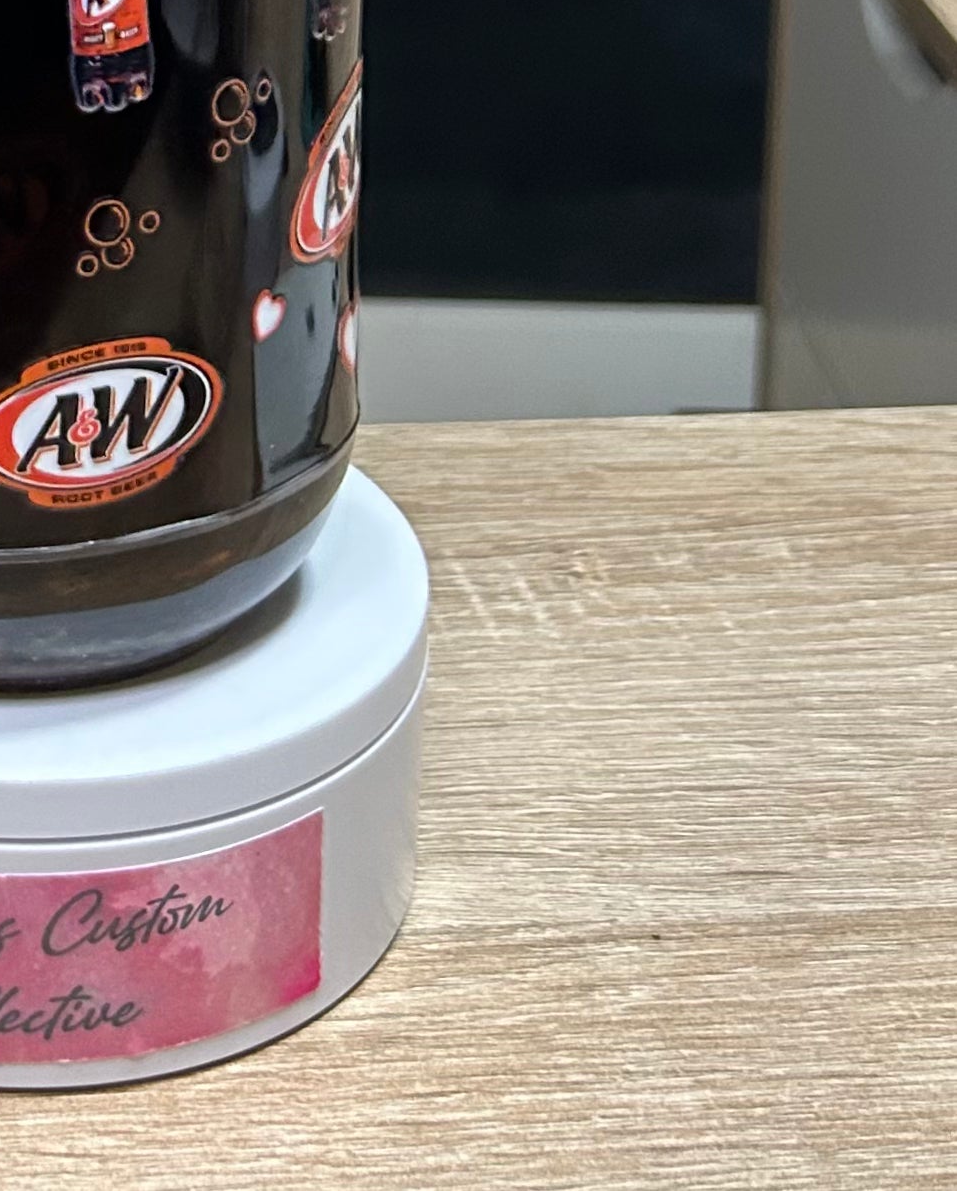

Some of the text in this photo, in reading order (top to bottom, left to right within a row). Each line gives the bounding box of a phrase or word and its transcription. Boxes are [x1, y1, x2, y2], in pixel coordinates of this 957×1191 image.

[47, 347, 105, 371] SINCE
[15, 365, 183, 474] A&W
[51, 471, 158, 505] ROOT BEER
[42, 884, 233, 957] Custom
